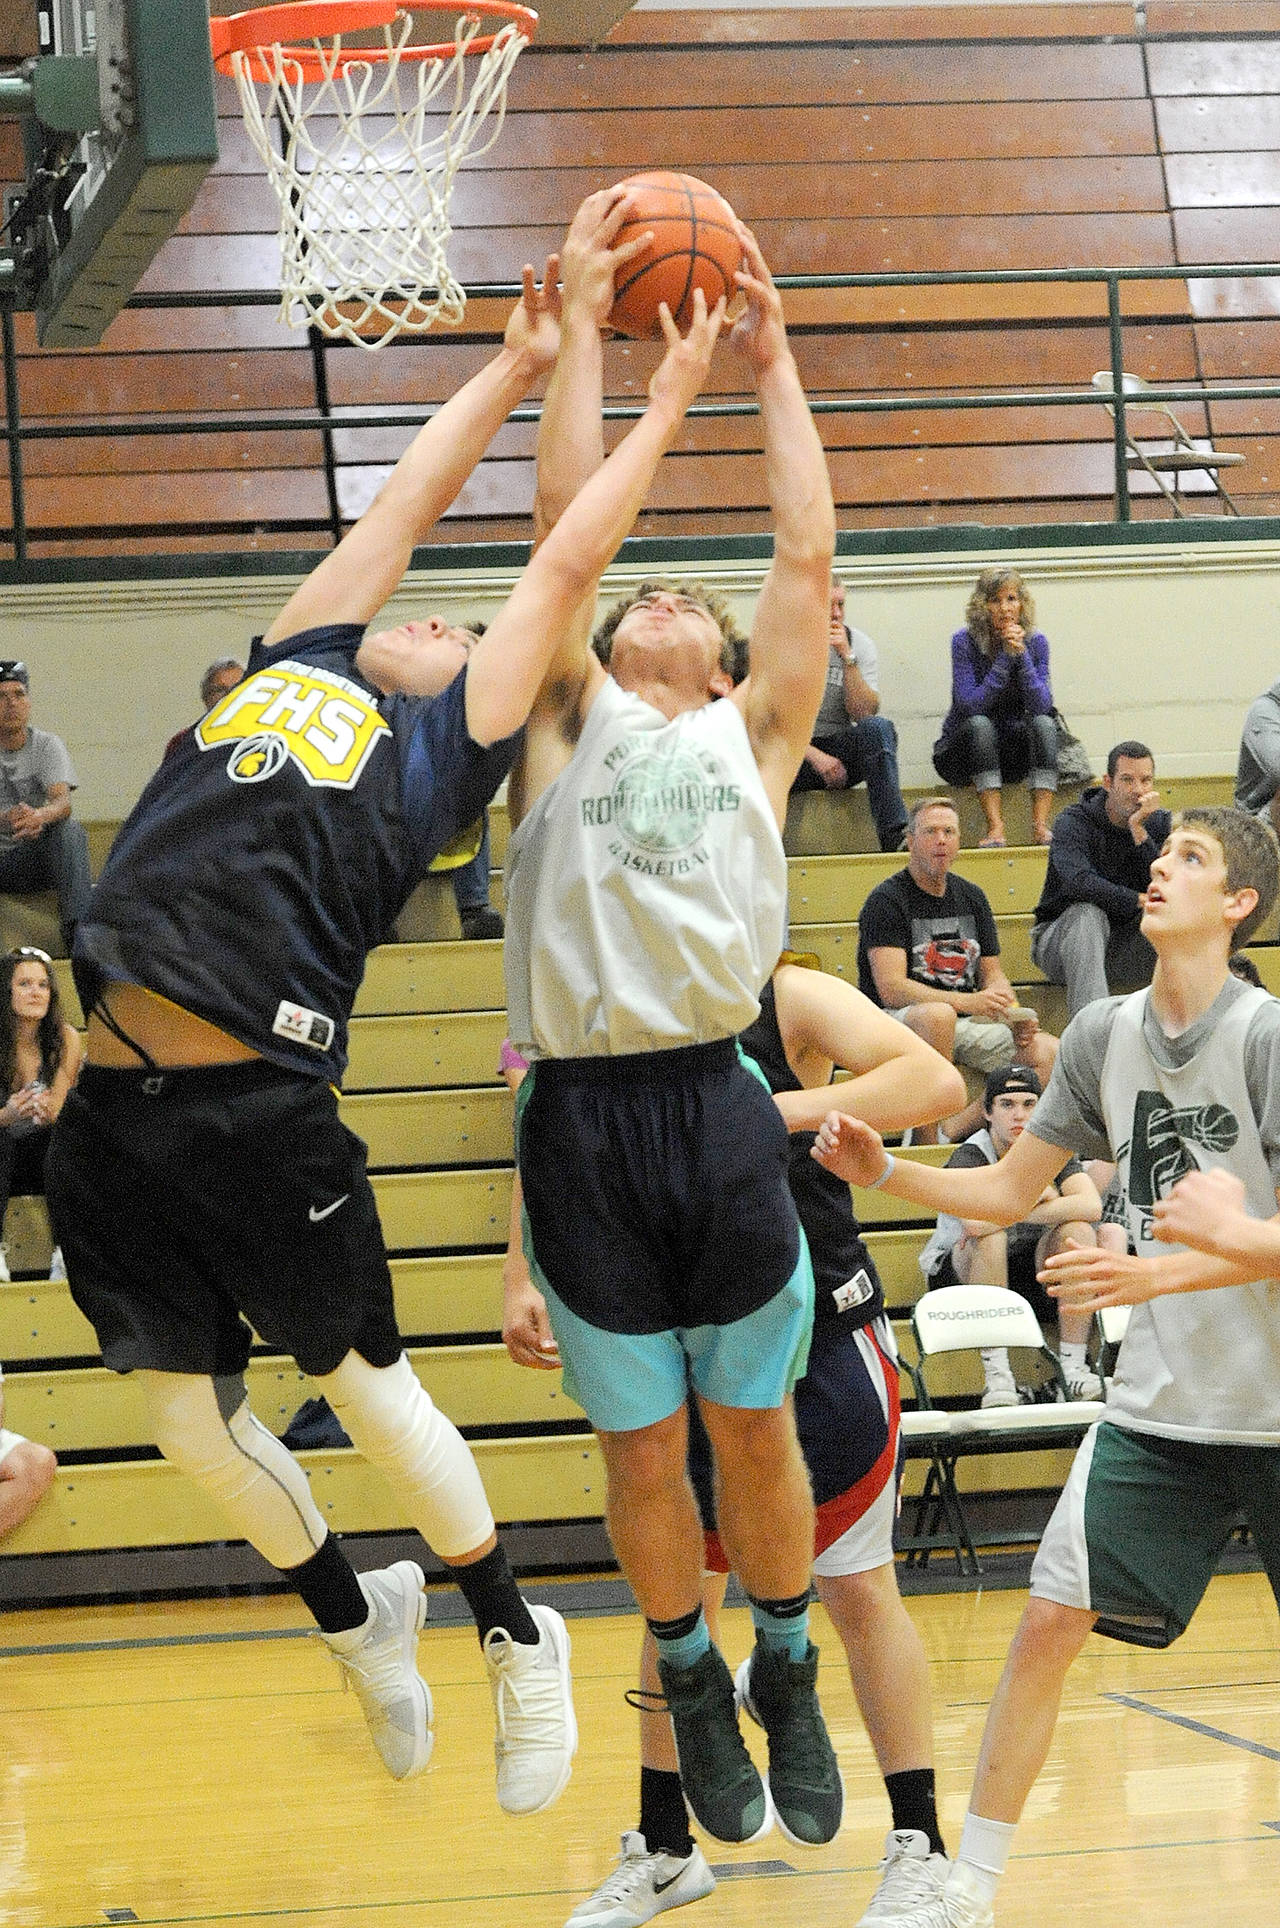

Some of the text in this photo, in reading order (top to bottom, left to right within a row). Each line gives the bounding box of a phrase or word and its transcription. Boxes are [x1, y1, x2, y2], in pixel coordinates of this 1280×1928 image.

[209, 674, 368, 766] FHS
[603, 736, 648, 771] POR
[608, 840, 711, 876] BASKETBAL
[927, 1305, 1025, 1321] ROUGHRIDERS
